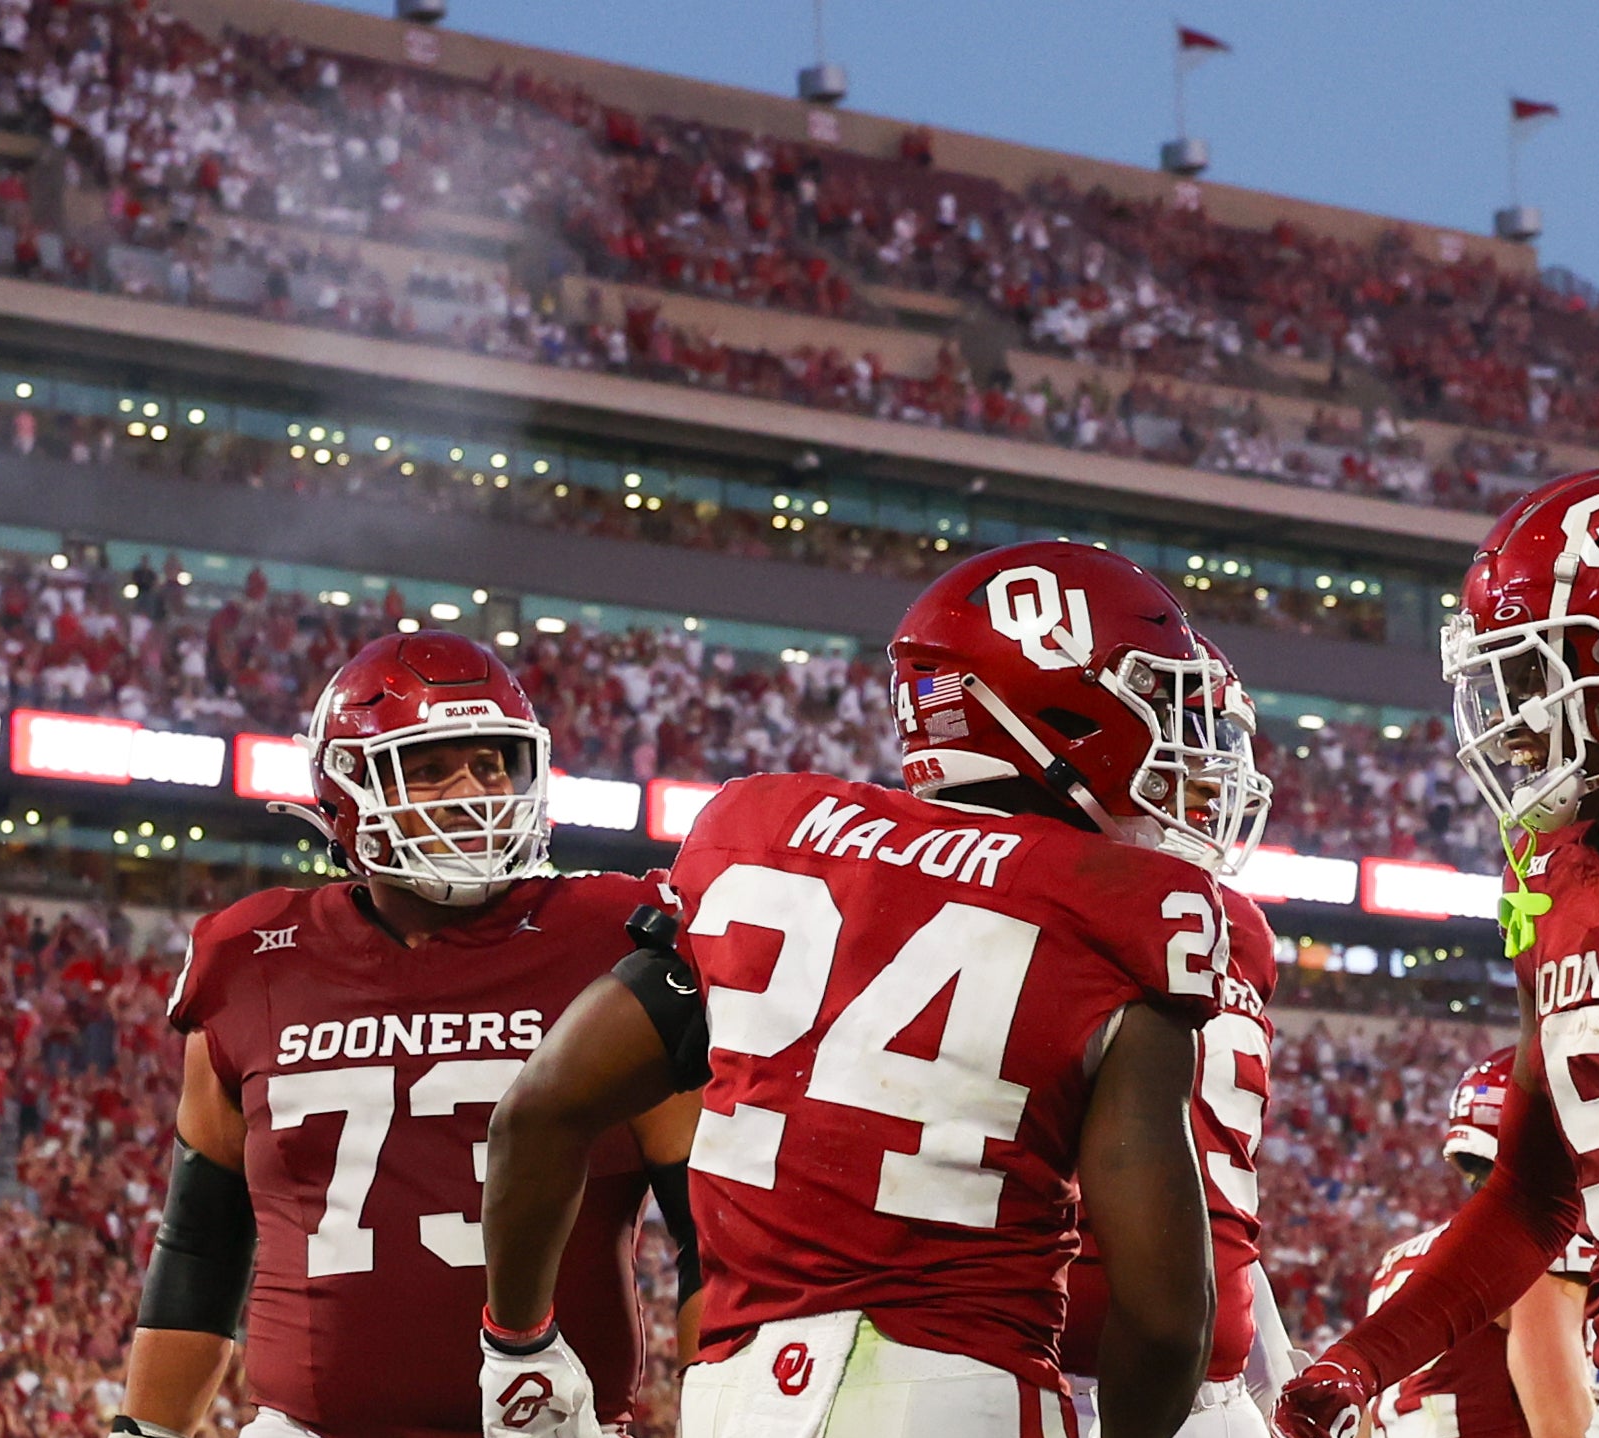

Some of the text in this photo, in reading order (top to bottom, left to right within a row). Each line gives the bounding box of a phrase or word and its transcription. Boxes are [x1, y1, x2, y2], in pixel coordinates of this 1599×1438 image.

[986, 565, 1094, 670] OU
[445, 706, 489, 717] OKLAHOMA
[787, 796, 1022, 888] MAJOR
[253, 925, 298, 954] XII
[276, 1009, 543, 1065] SOONERS
[687, 863, 1041, 1229] 24
[267, 1058, 527, 1278] 73
[772, 1342, 815, 1396] OU
